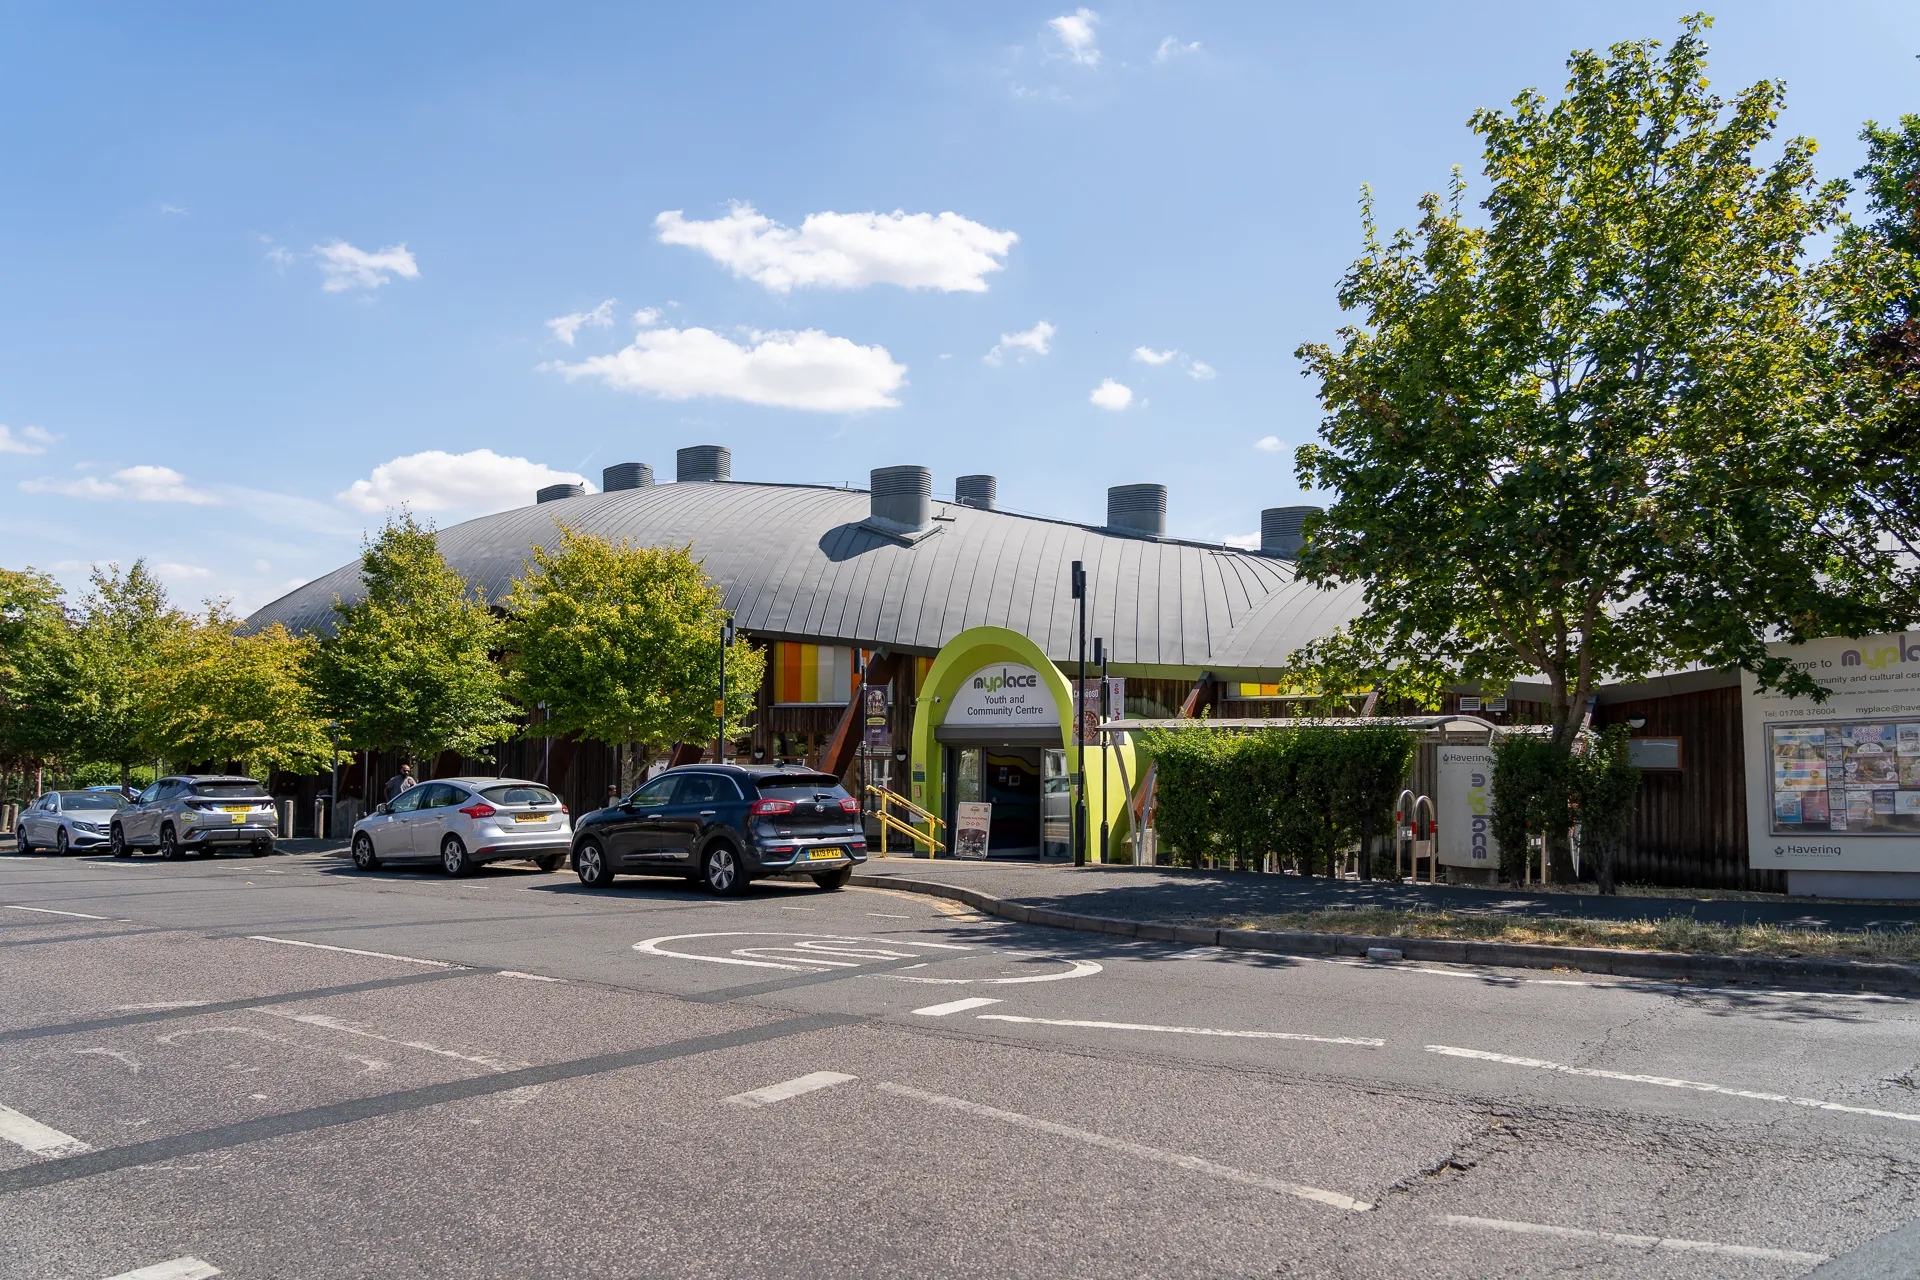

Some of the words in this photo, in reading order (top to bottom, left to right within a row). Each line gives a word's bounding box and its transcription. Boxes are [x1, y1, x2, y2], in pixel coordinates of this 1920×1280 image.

[1821, 659, 1832, 669] to
[974, 668, 1037, 692] myplace
[1812, 675, 1847, 685] mmunity
[1869, 672, 1903, 681] cultural
[985, 695, 1007, 704] Youth
[1010, 695, 1025, 704] and
[967, 706, 1013, 716] Community
[1015, 705, 1043, 714] Centre
[1779, 708, 1804, 717] 01708
[1806, 707, 1836, 715] 376004
[1467, 773, 1491, 860] myplace
[1787, 845, 1842, 856] Havering
